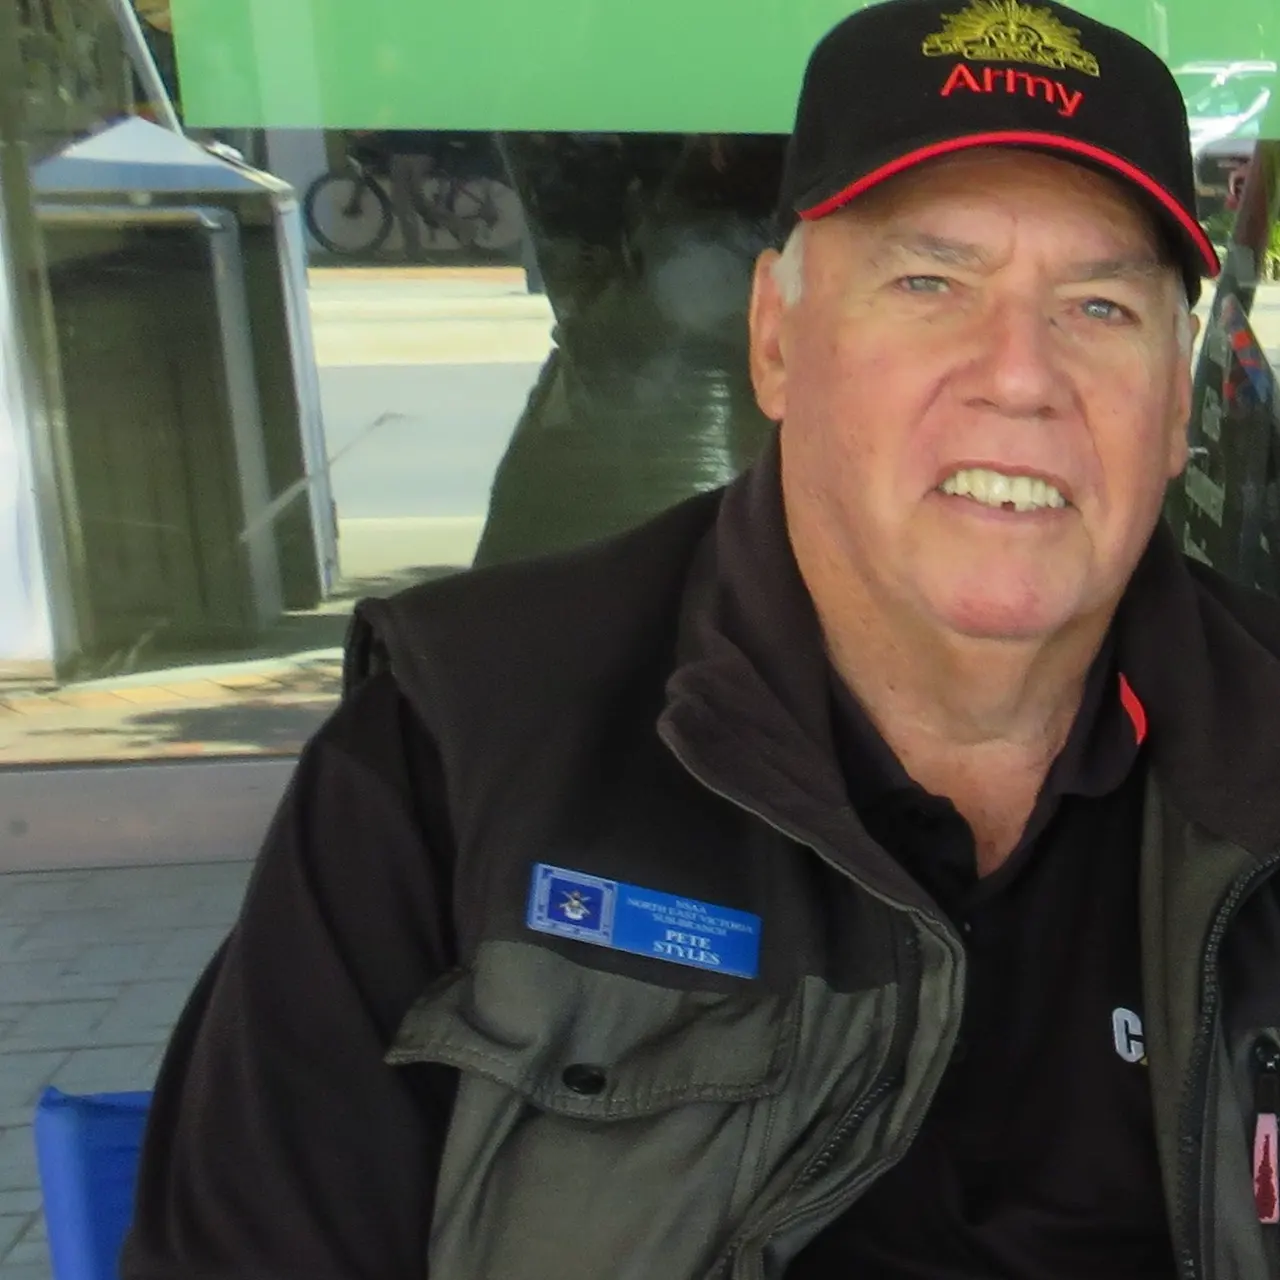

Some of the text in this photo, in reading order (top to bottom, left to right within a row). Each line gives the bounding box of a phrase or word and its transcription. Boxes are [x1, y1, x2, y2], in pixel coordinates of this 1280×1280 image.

[941, 64, 1083, 117] Army
[665, 930, 711, 949] PETE
[654, 941, 721, 966] STYLES
